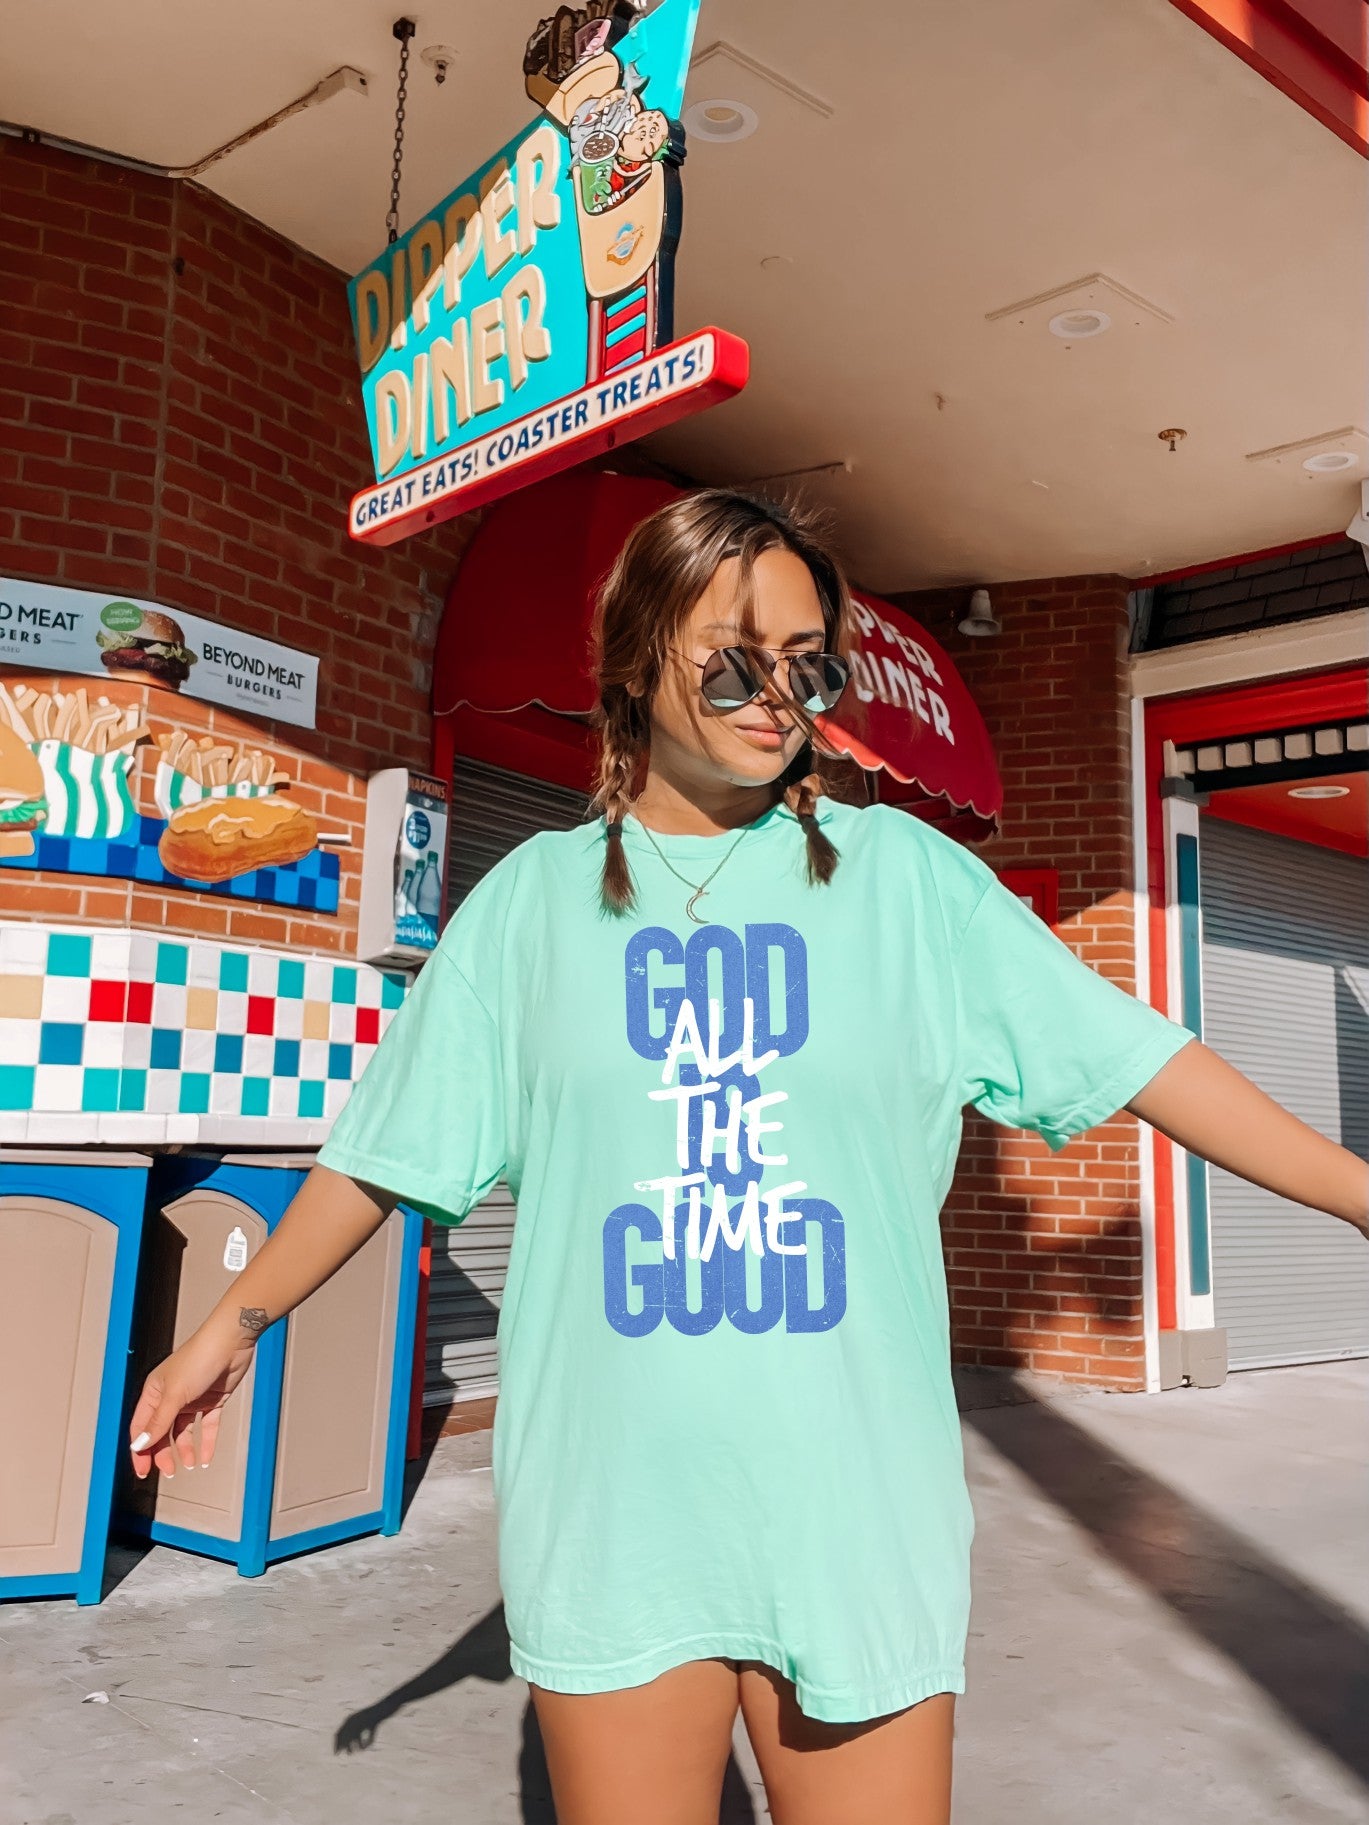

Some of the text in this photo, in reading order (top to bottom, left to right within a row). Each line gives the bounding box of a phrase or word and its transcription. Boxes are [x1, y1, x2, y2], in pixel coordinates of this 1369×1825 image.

[356, 126, 560, 374] DIPPER
[375, 264, 552, 477] DINER
[356, 344, 705, 527] GREAT EATS! COASTER TREATS!
[18, 604, 81, 631] MEAT
[203, 642, 306, 690] BEYOND MEAT
[227, 674, 282, 700] BURGERS
[625, 923, 809, 1061] GOD
[662, 997, 779, 1084] ALL
[648, 1081, 788, 1175] THE
[634, 1172, 807, 1262] TIME
[602, 1198, 847, 1338] GOOD
